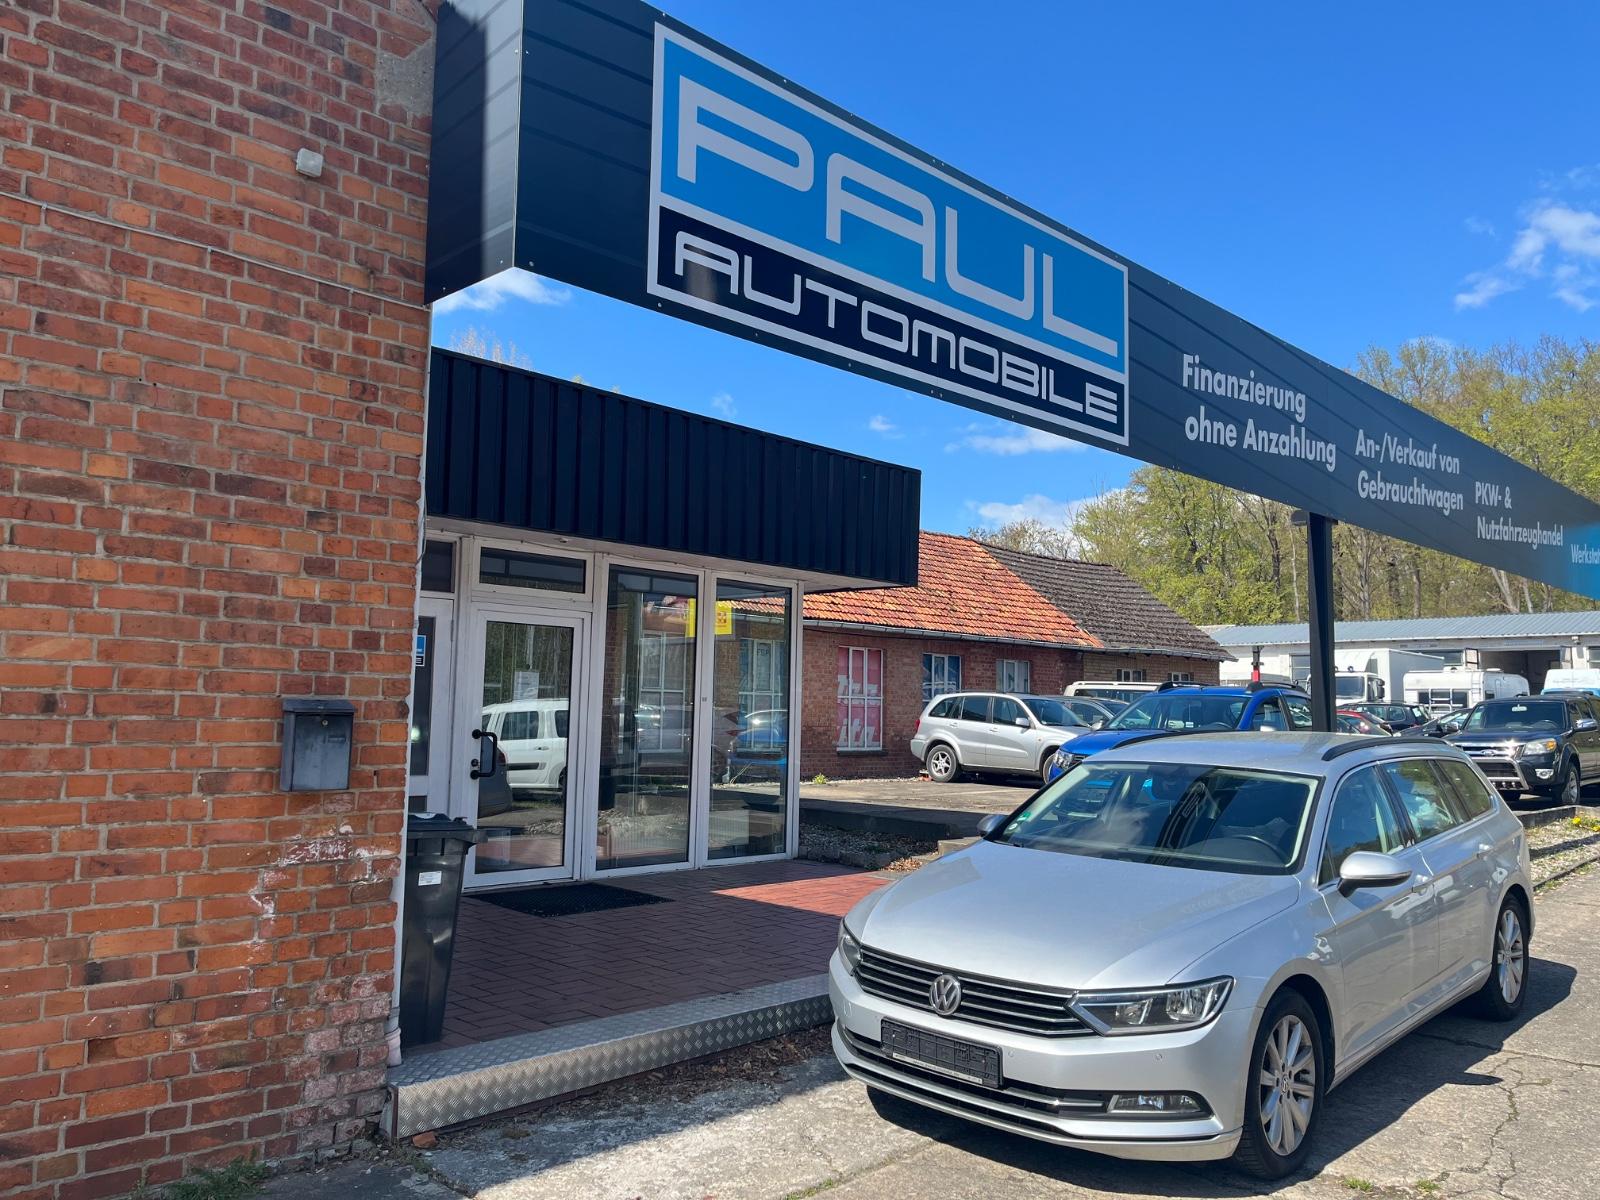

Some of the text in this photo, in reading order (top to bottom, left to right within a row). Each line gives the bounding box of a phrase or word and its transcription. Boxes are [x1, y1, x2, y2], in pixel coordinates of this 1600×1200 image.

[676, 74, 1118, 358] PAUL
[675, 230, 1118, 424] AUTOMOBILE
[1182, 353, 1306, 423] Finanzierung
[1185, 405, 1337, 473] ohne Anzahlung
[1355, 429, 1460, 475] An-/Verkauf von
[1357, 470, 1464, 516] Gebrauchtwagen
[1475, 481, 1513, 509] PKW- &
[1477, 516, 1564, 550] Nutzfahrzeughandel
